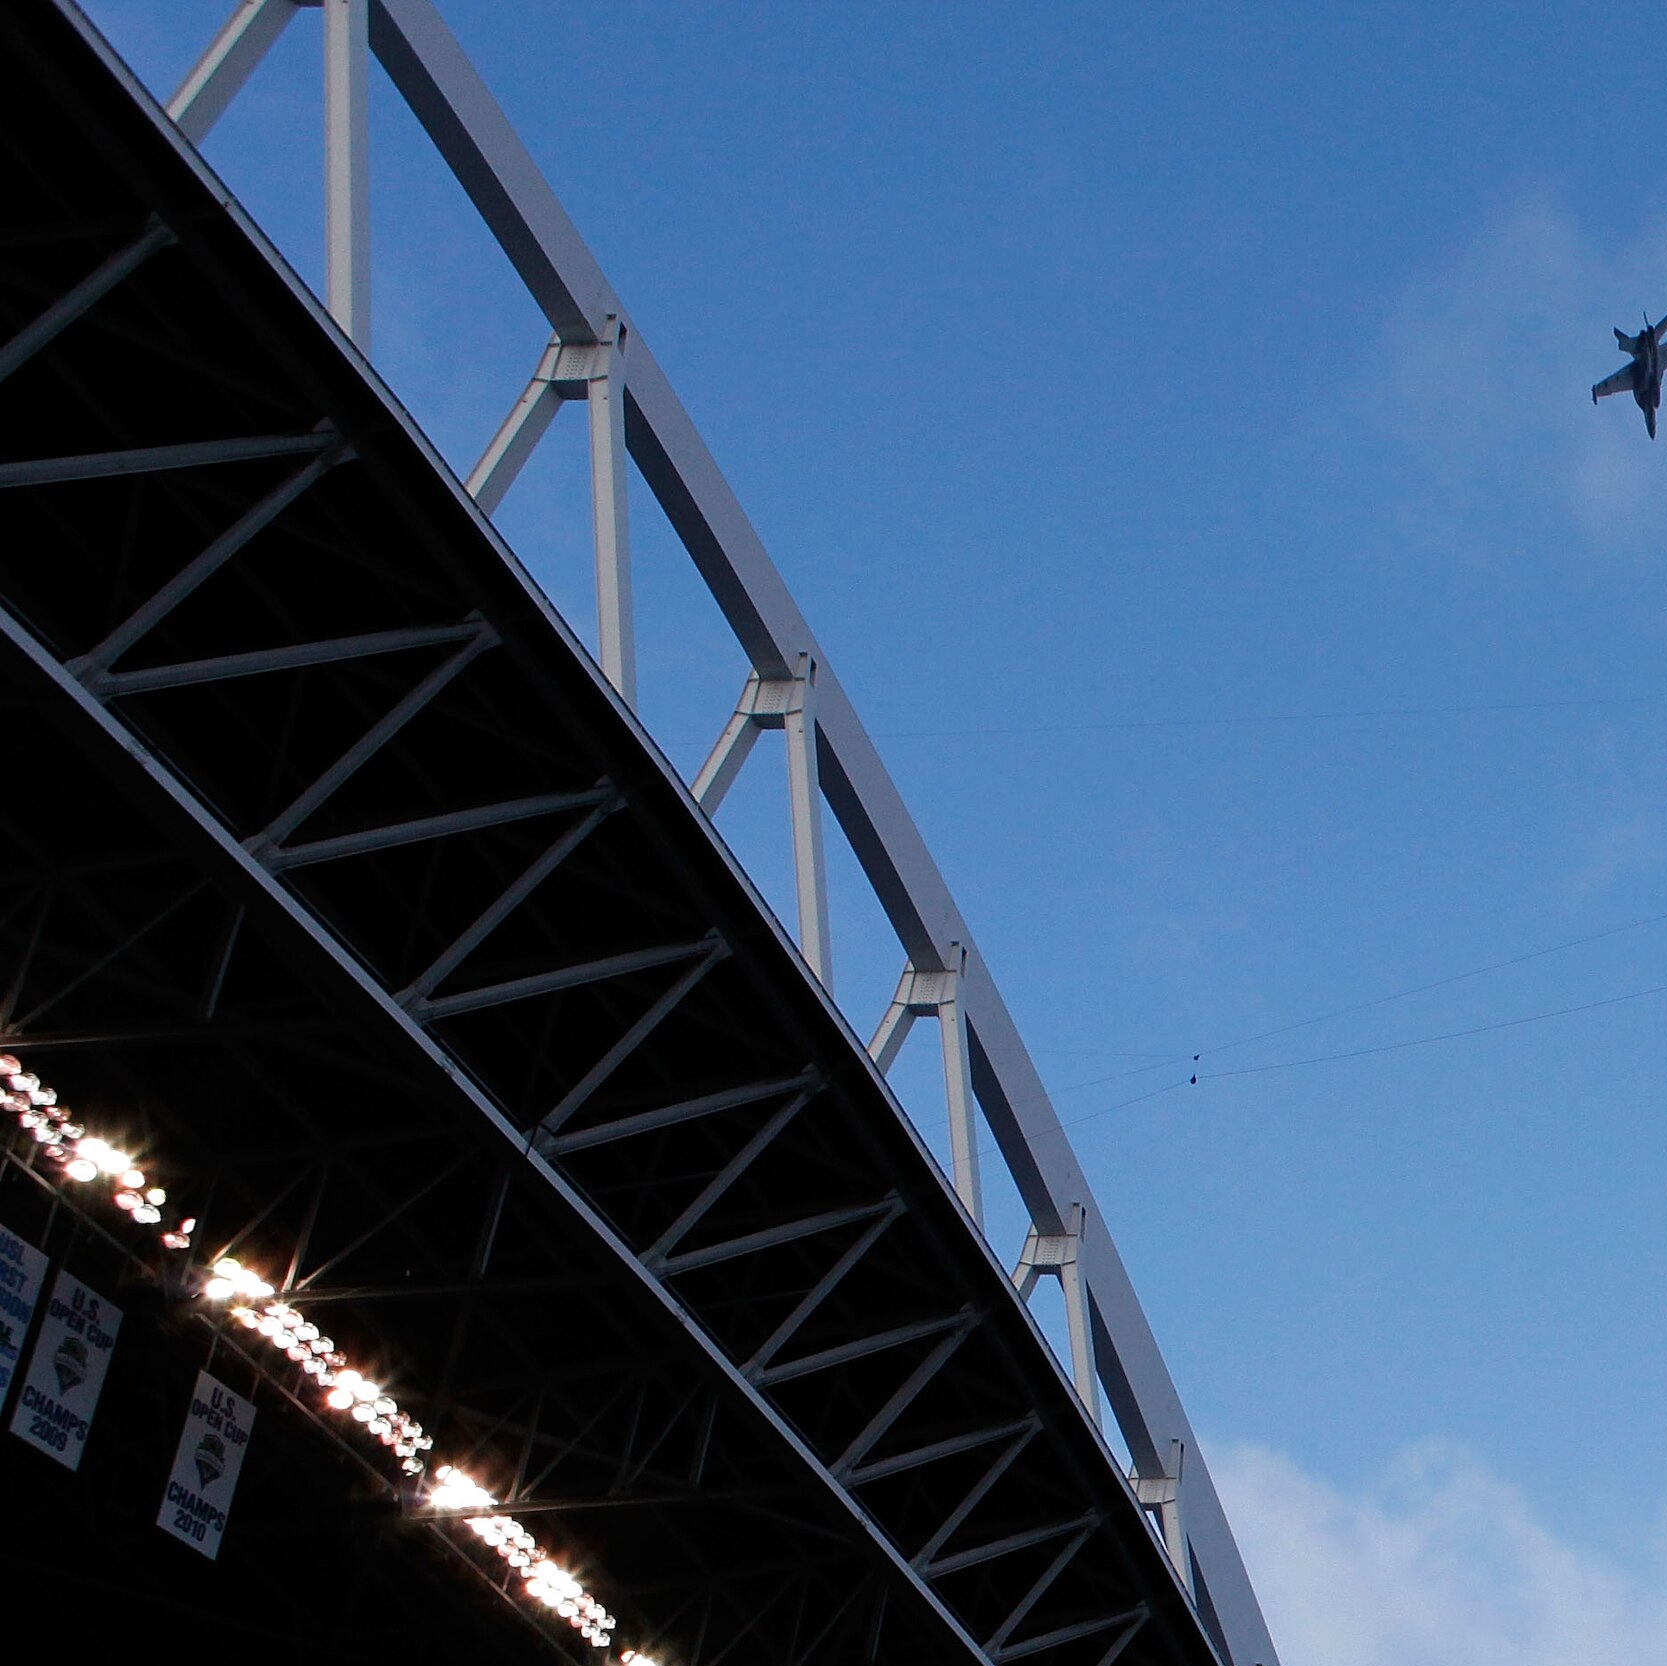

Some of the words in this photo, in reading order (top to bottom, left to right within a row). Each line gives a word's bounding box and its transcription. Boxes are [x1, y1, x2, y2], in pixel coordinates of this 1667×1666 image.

[50, 1298, 86, 1333] OPEN
[87, 1323, 113, 1350] CUP
[72, 1287, 101, 1325] U.S.
[22, 1385, 88, 1441] CHAMPS
[192, 1400, 223, 1435] OPEN
[225, 1420, 249, 1447] CUP
[211, 1386, 236, 1420] U.S.
[30, 1416, 68, 1452] 2009
[167, 1480, 226, 1533] CHAMPS
[174, 1509, 206, 1543] 2010
